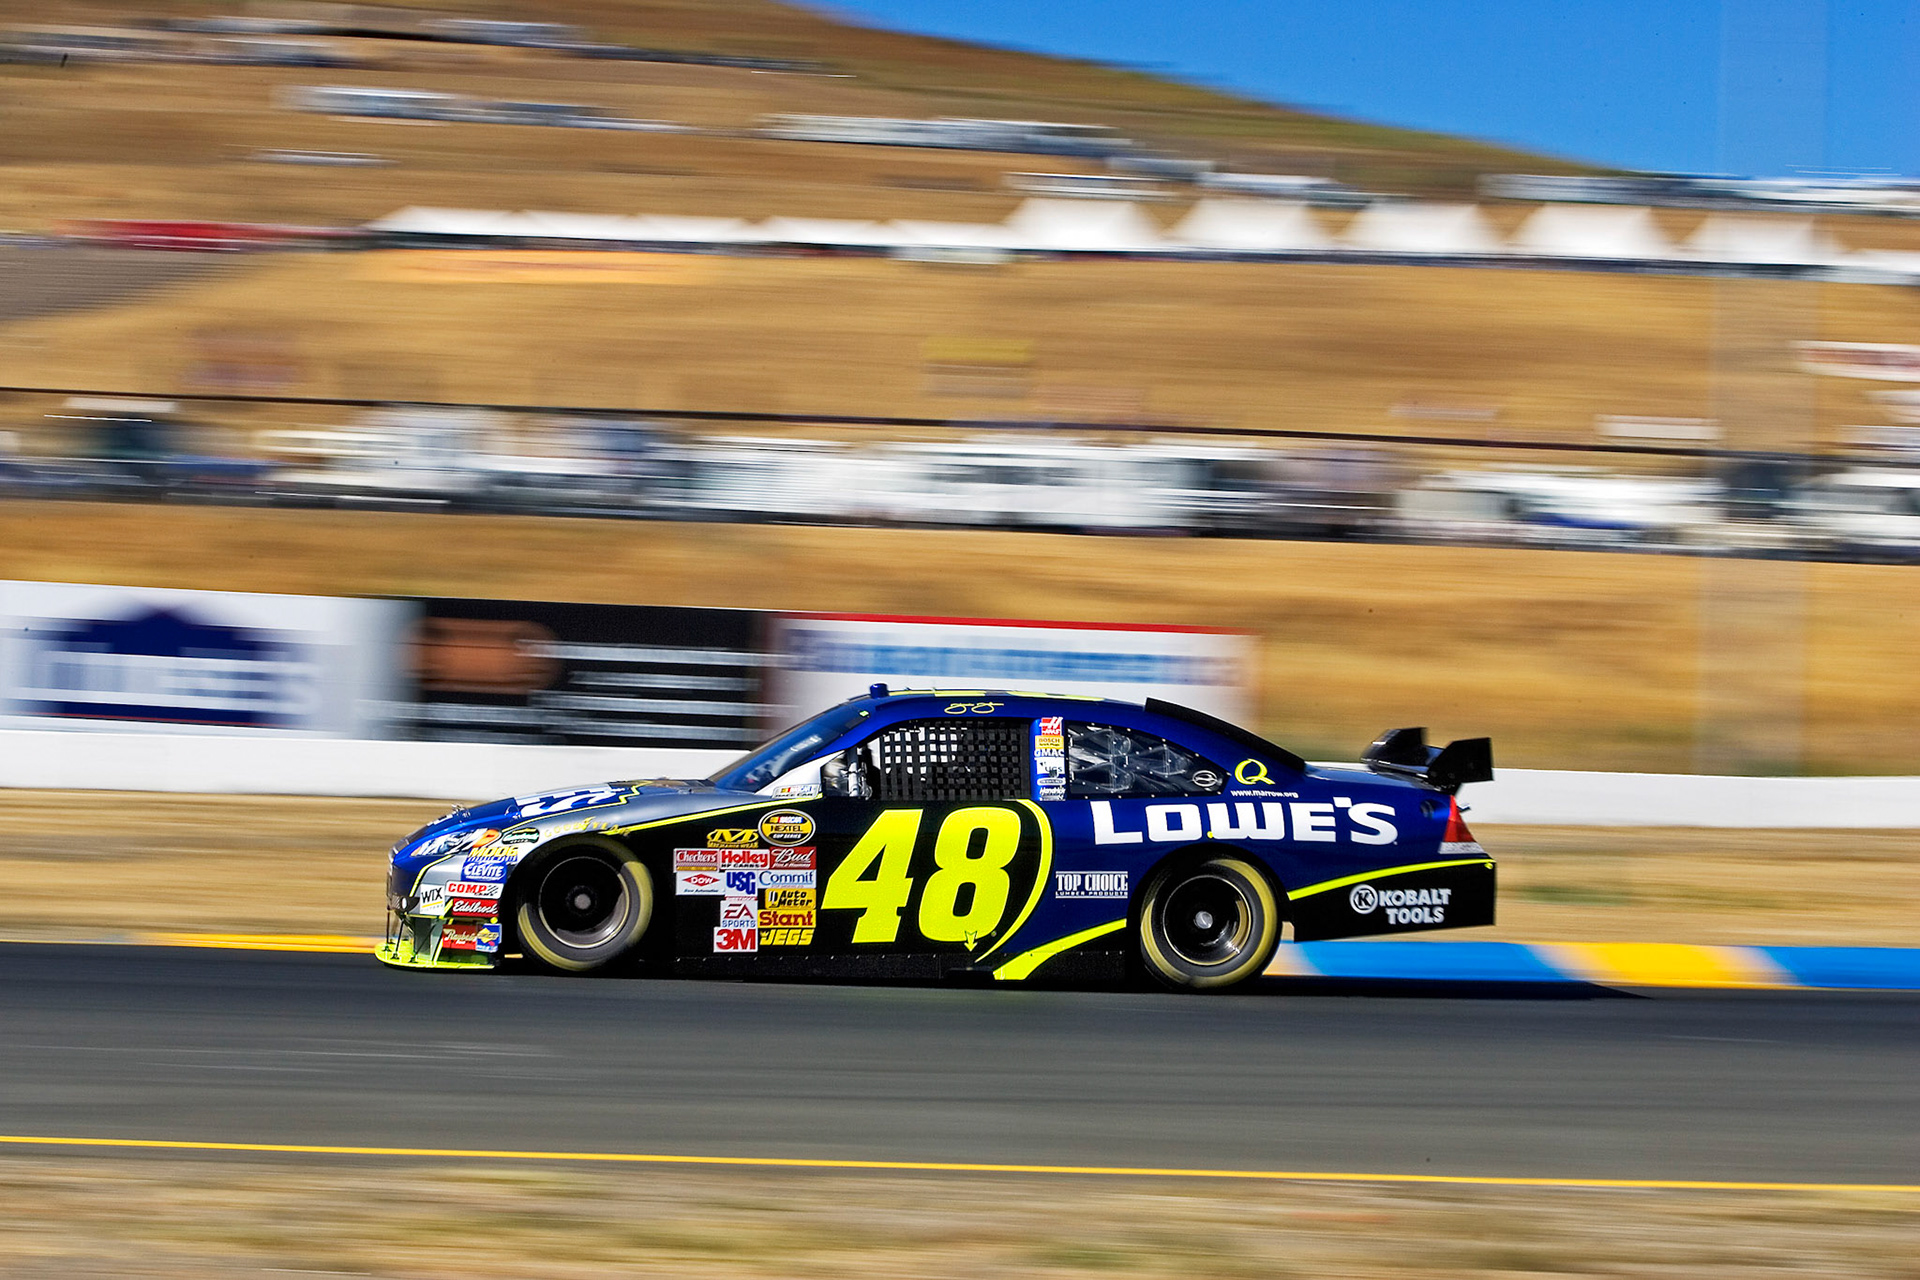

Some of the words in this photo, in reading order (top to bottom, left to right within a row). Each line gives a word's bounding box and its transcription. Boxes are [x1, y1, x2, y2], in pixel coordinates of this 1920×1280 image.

[1034, 748, 1065, 757] GMAC
[1234, 758, 1276, 785] Q
[1230, 789, 1299, 798] www.marrow.org
[543, 816, 631, 837] GOODYEAR
[1090, 796, 1398, 846] LOWE'S
[468, 846, 519, 857] MOOG
[676, 851, 717, 863] Checkers
[720, 850, 768, 867] Holley
[771, 848, 815, 863] Bud
[759, 870, 814, 885] Commit
[821, 806, 1022, 943] 48
[1055, 874, 1082, 891] TOP
[1084, 874, 1129, 891] CHOICE
[448, 882, 487, 894] COMP
[726, 871, 756, 895] USG
[421, 887, 443, 904] WIX
[780, 890, 807, 899] Auto
[1378, 888, 1452, 907] KOBALT
[723, 903, 754, 919] EA
[777, 899, 813, 907] Meter
[721, 919, 757, 928] SPORTS
[759, 911, 813, 926] Stant
[1385, 906, 1445, 925] TOOLS
[716, 928, 756, 950] 3M
[759, 929, 814, 945] JEGS
